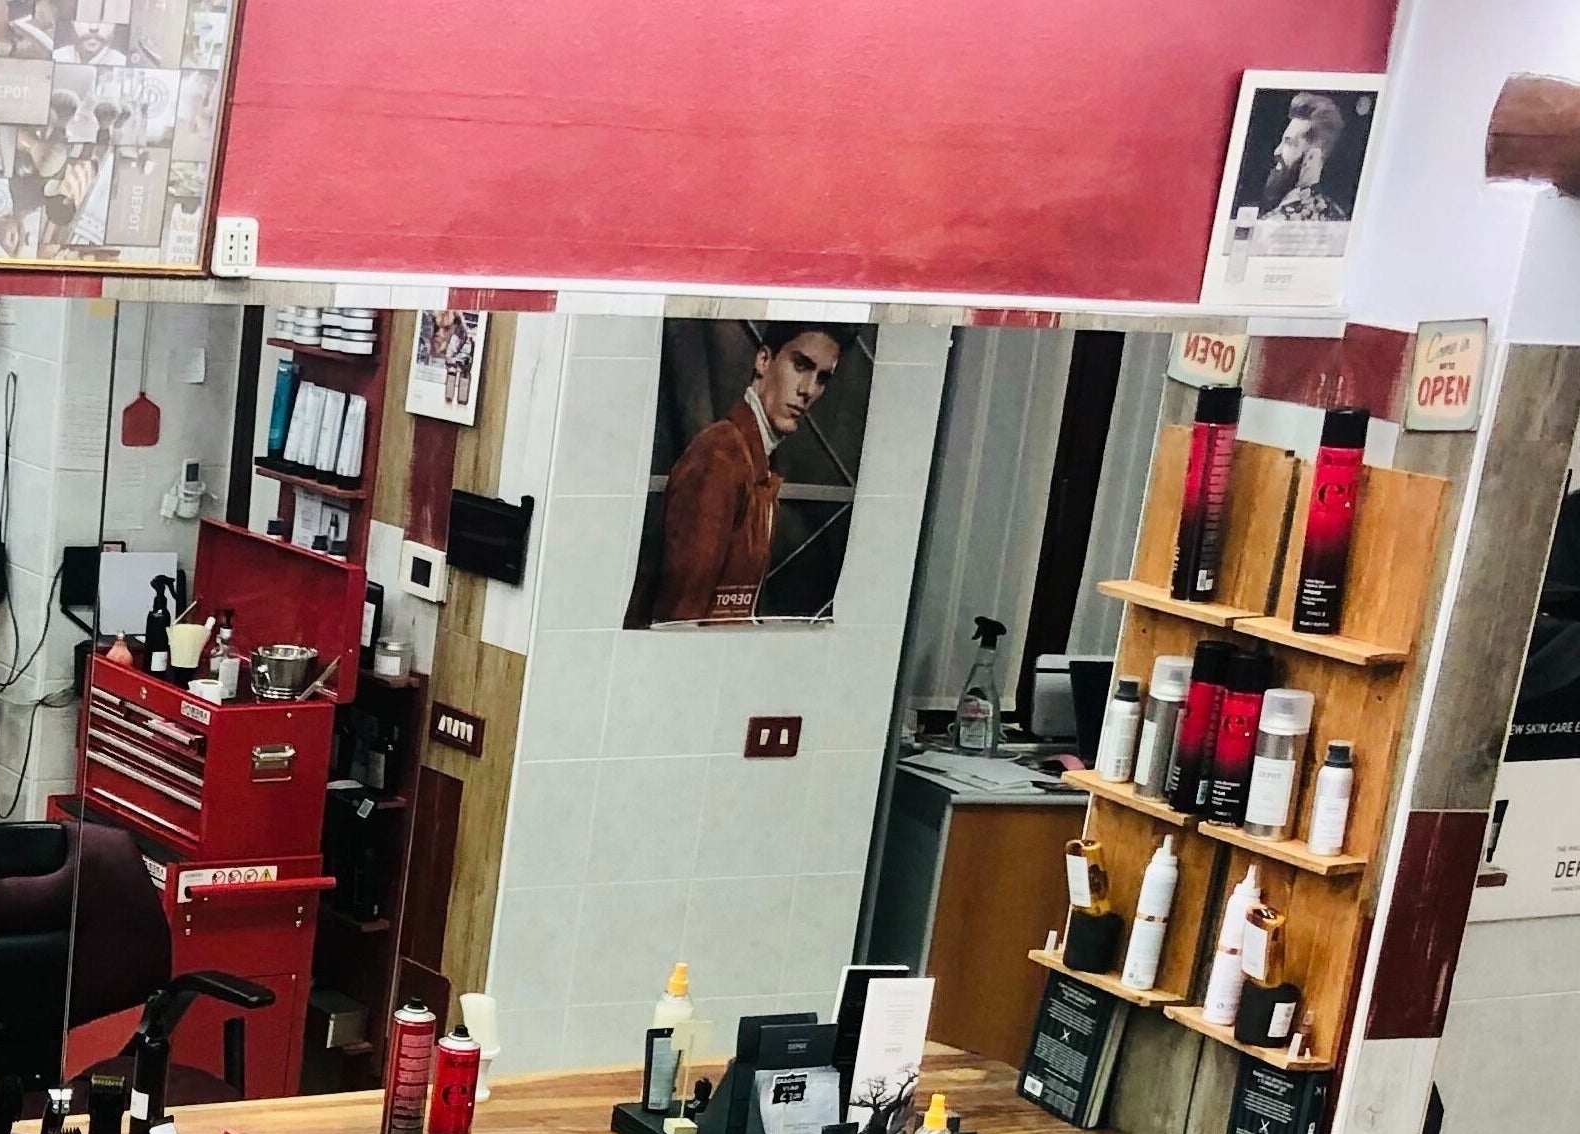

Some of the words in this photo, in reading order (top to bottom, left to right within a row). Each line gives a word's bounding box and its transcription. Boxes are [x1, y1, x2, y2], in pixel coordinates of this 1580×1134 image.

[128, 186, 144, 232] DEPOT
[1417, 375, 1472, 407] OPEN
[1525, 723, 1548, 735] SKIN
[1549, 721, 1573, 734] CARE
